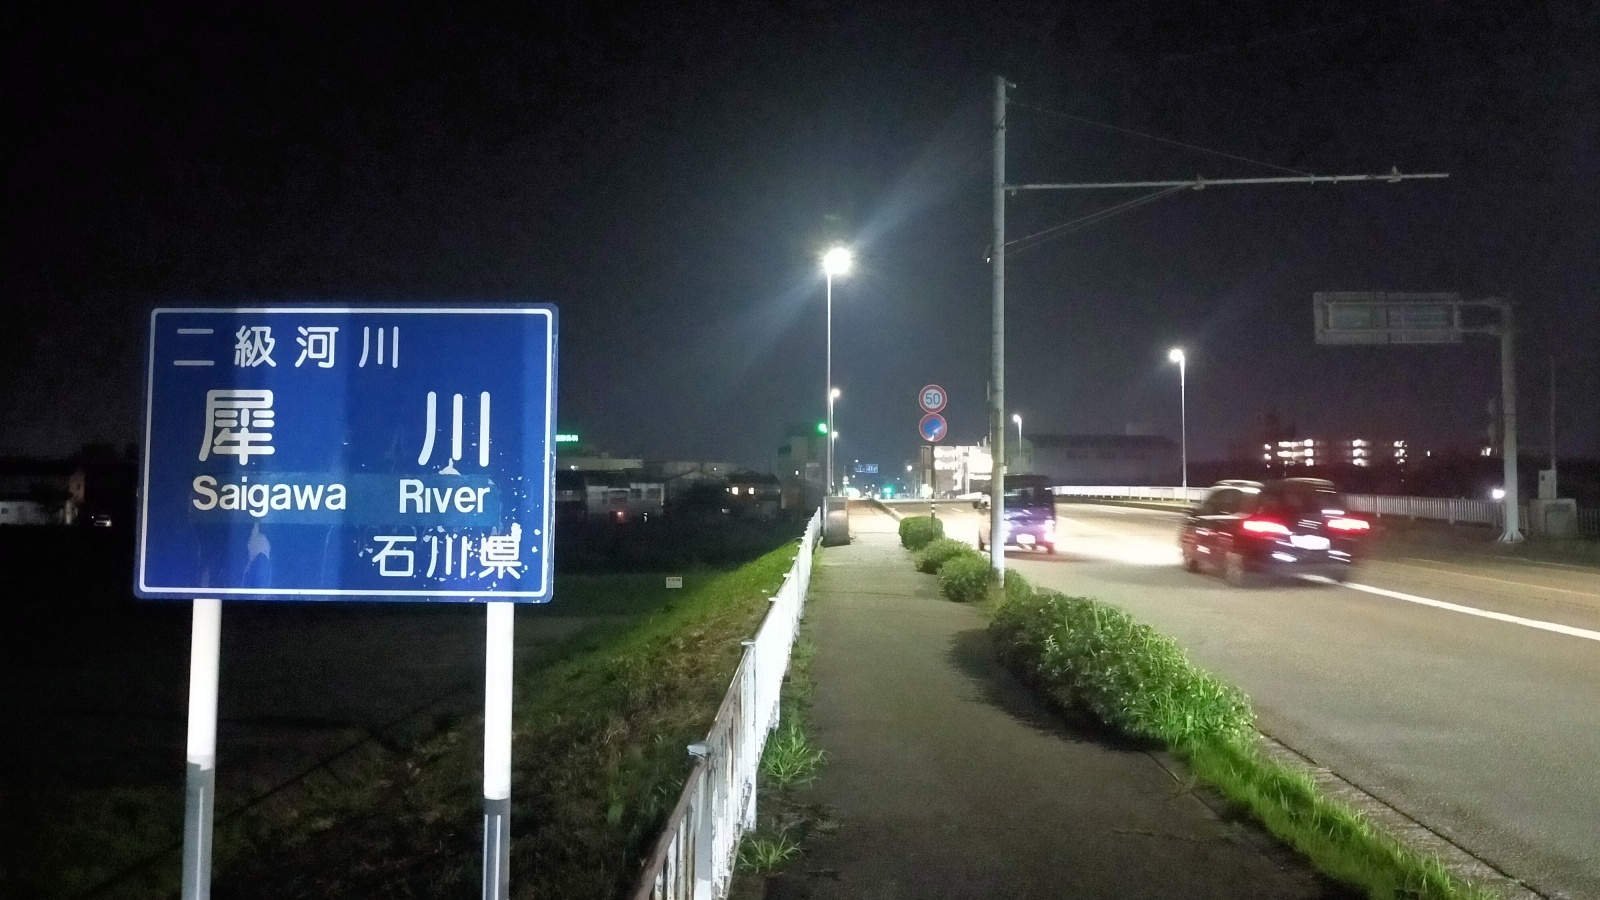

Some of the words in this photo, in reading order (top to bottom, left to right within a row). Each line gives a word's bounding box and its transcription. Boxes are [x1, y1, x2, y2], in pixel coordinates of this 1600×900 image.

[173, 326, 400, 368] 二級河川
[925, 392, 941, 405] 50
[192, 475, 347, 517] Saigawa
[399, 479, 491, 513] River
[371, 535, 522, 580] 石川県
